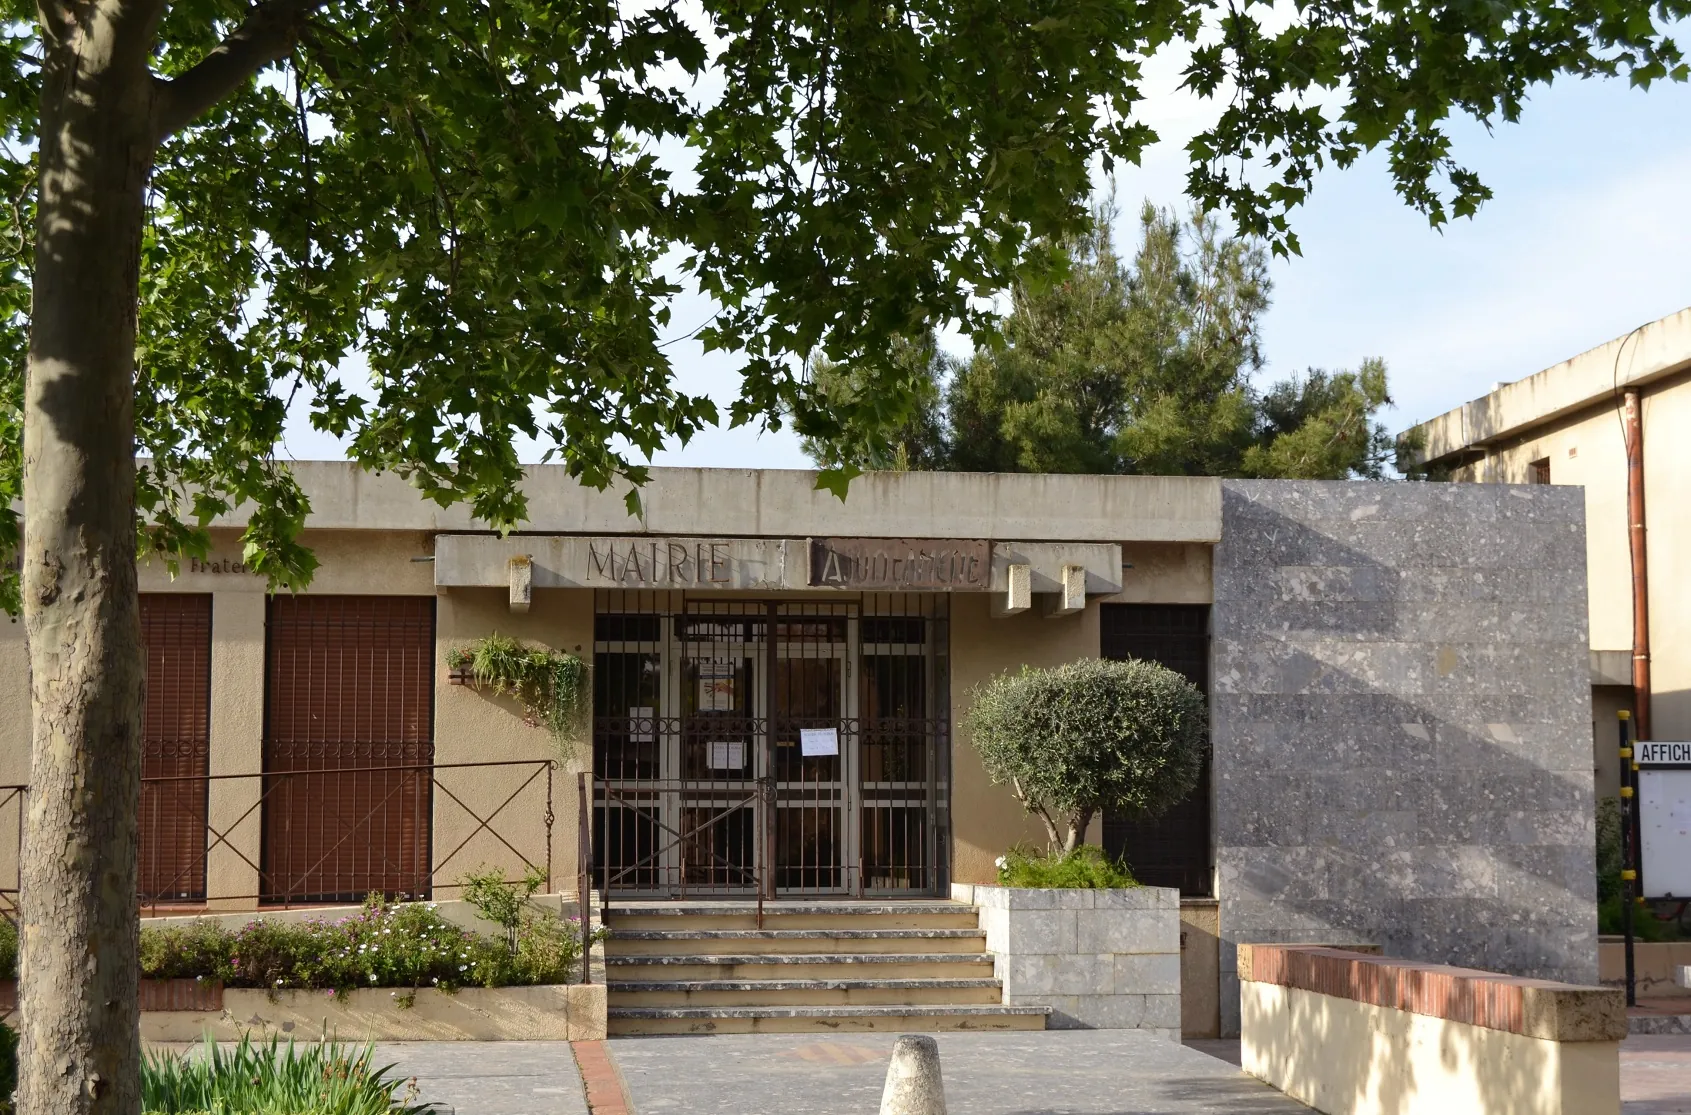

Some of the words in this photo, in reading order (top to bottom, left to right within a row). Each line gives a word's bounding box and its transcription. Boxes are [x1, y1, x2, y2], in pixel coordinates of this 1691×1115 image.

[190, 556, 248, 574] Frater
[586, 541, 731, 583] MAIRIE
[1641, 744, 1691, 761] AFFICH
